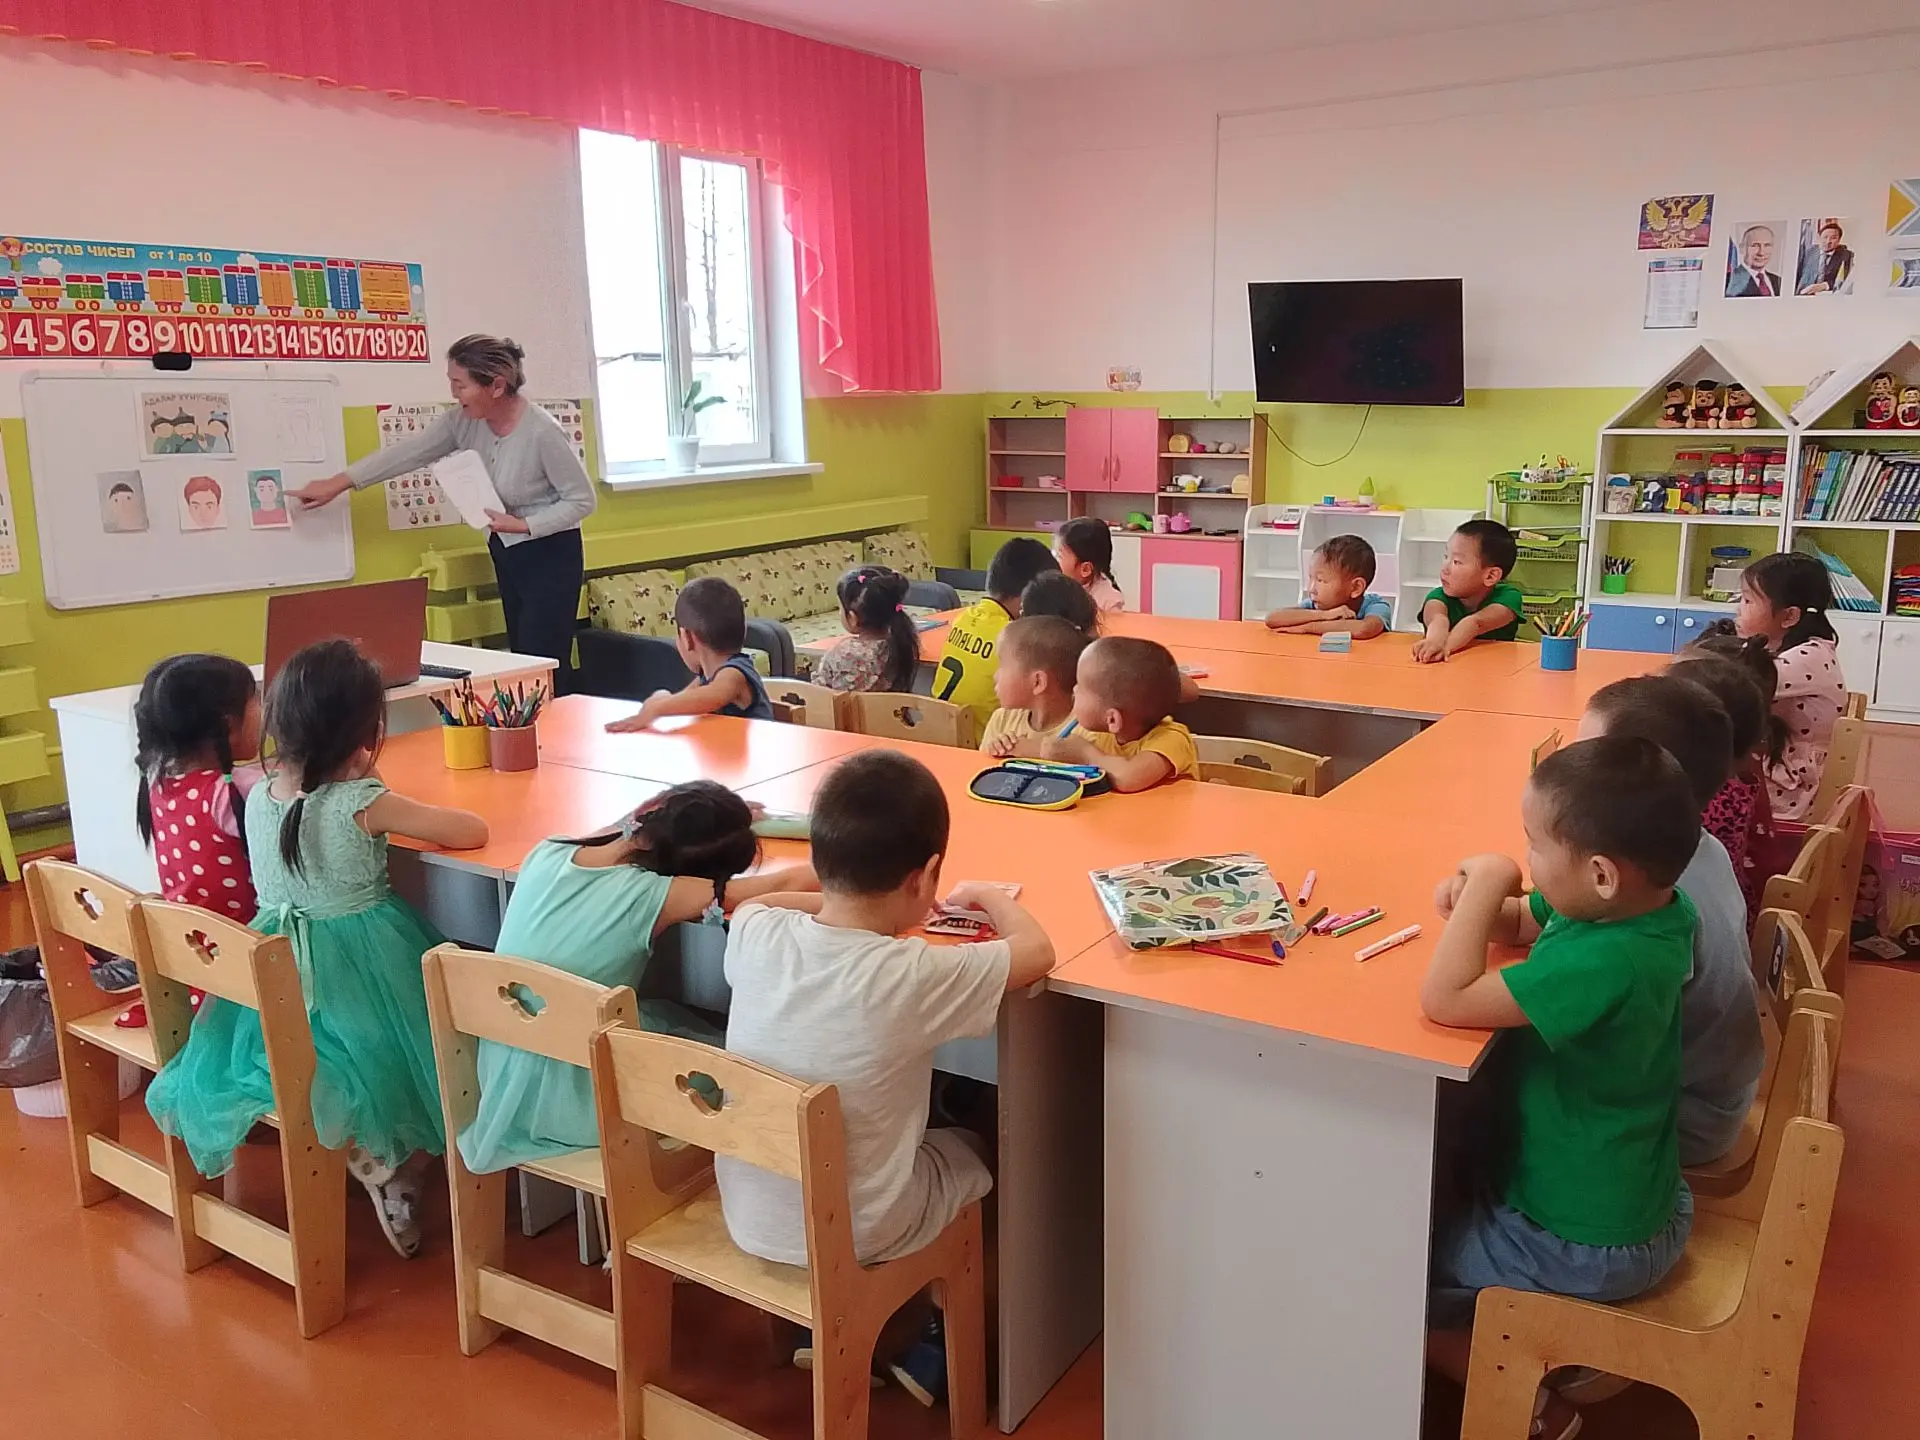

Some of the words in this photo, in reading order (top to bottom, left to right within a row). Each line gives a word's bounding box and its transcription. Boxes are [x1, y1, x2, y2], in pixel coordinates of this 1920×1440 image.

[25, 242, 83, 256] СОСТАВ
[88, 245, 136, 259] ЧИСЕЛ
[150, 251, 163, 260] от
[168, 250, 174, 260] 1
[178, 254, 194, 263] до
[198, 252, 212, 263] 10
[13, 318, 38, 352] 4
[44, 318, 66, 352] 5
[71, 318, 95, 352] 6
[99, 320, 120, 352] 7
[127, 319, 150, 353] 8
[153, 320, 177, 353] 9
[179, 322, 203, 354] 10
[204, 323, 229, 354] 11
[229, 324, 254, 355] 12
[252, 324, 277, 355] 13
[277, 325, 300, 355] 14
[301, 325, 322, 356] 15
[323, 326, 345, 356] 16
[344, 327, 365, 356] 17
[366, 327, 386, 356] 18
[387, 328, 407, 357] 19
[408, 329, 426, 357] 20
[948, 627, 993, 659] ONALDO
[937, 656, 964, 701] 7
